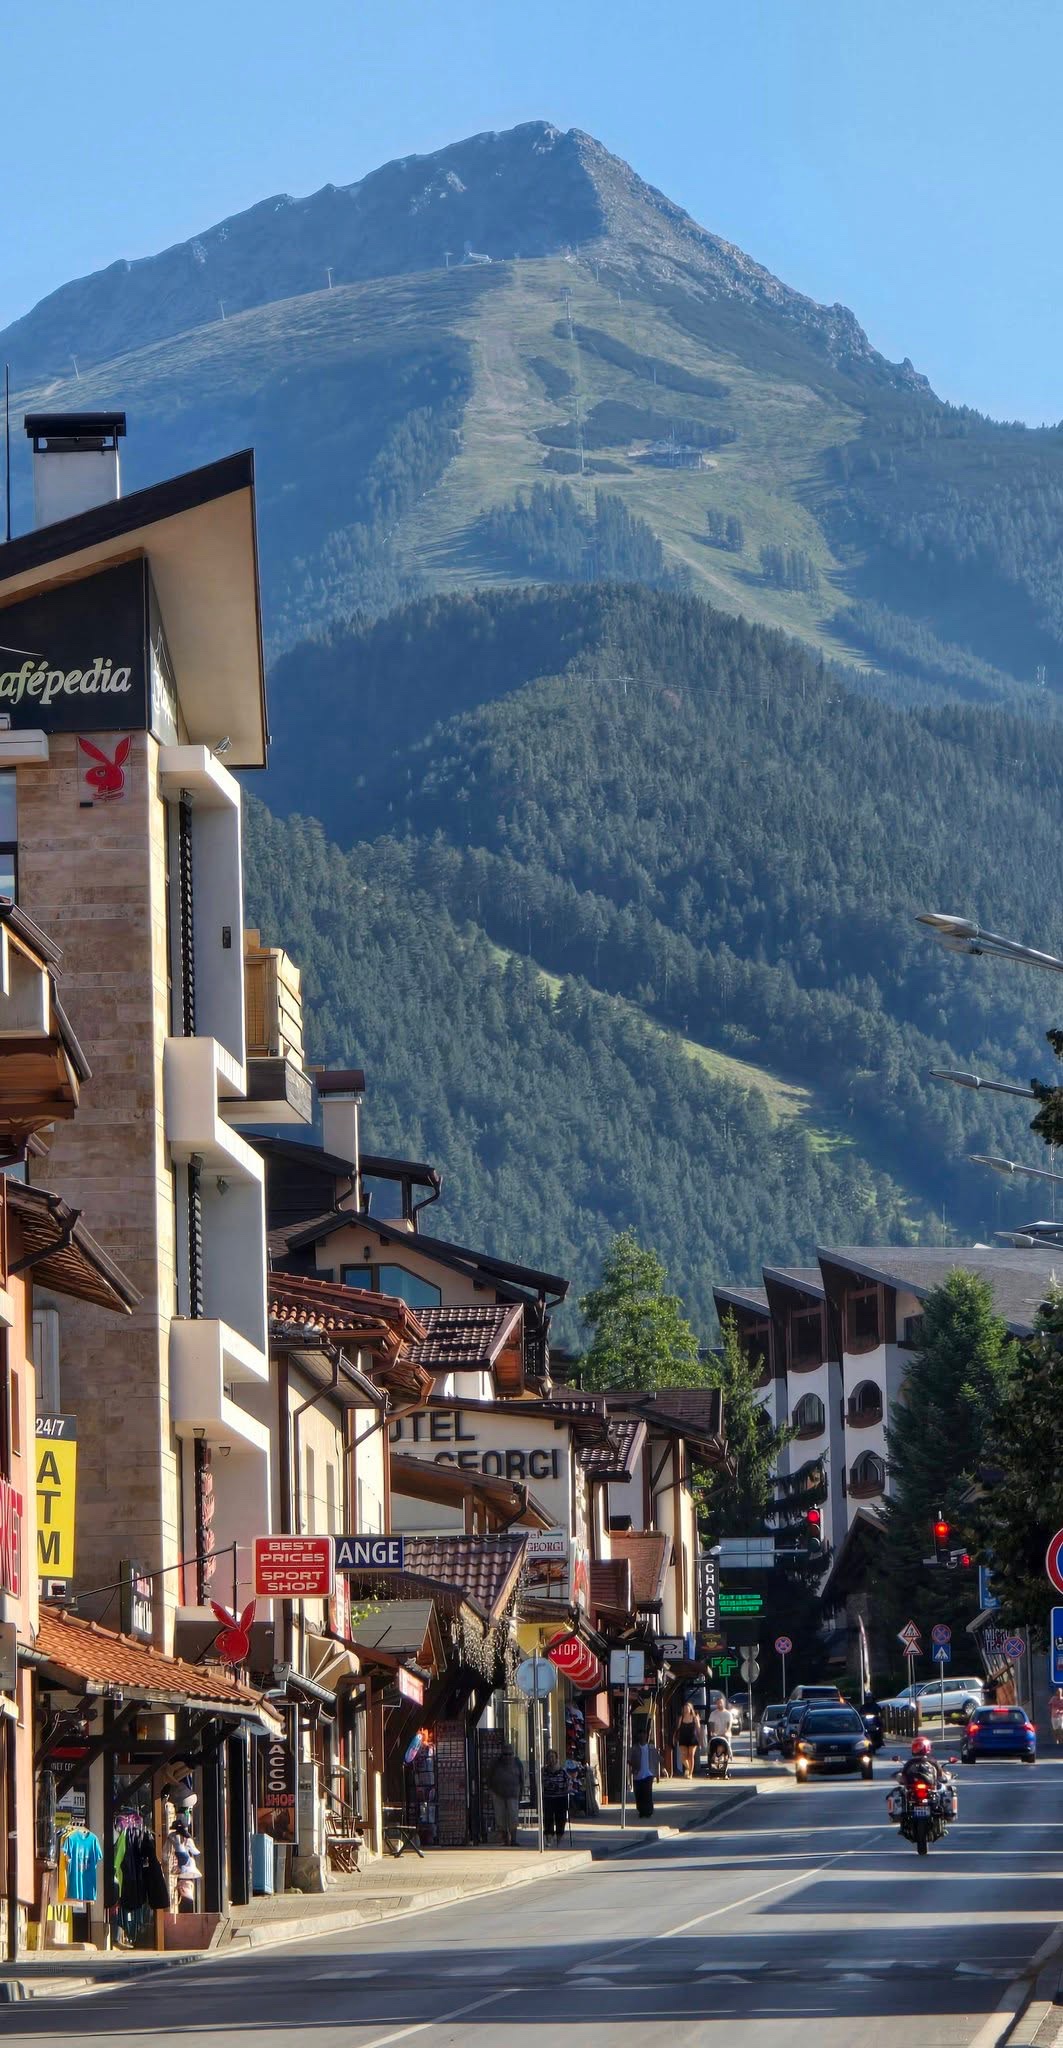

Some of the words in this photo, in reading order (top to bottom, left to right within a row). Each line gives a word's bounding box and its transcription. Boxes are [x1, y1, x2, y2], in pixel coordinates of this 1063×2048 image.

[36, 1418, 65, 1436] 24/7
[36, 1450, 62, 1566] ATM
[269, 1542, 316, 1551] BEST
[337, 1541, 399, 1564] ANGE
[260, 1553, 325, 1563] PRICES
[261, 1571, 324, 1581] SPORT
[267, 1582, 318, 1592] SHOP
[705, 1563, 716, 1629] CHANGE
[265, 1793, 295, 1807] SHOP
